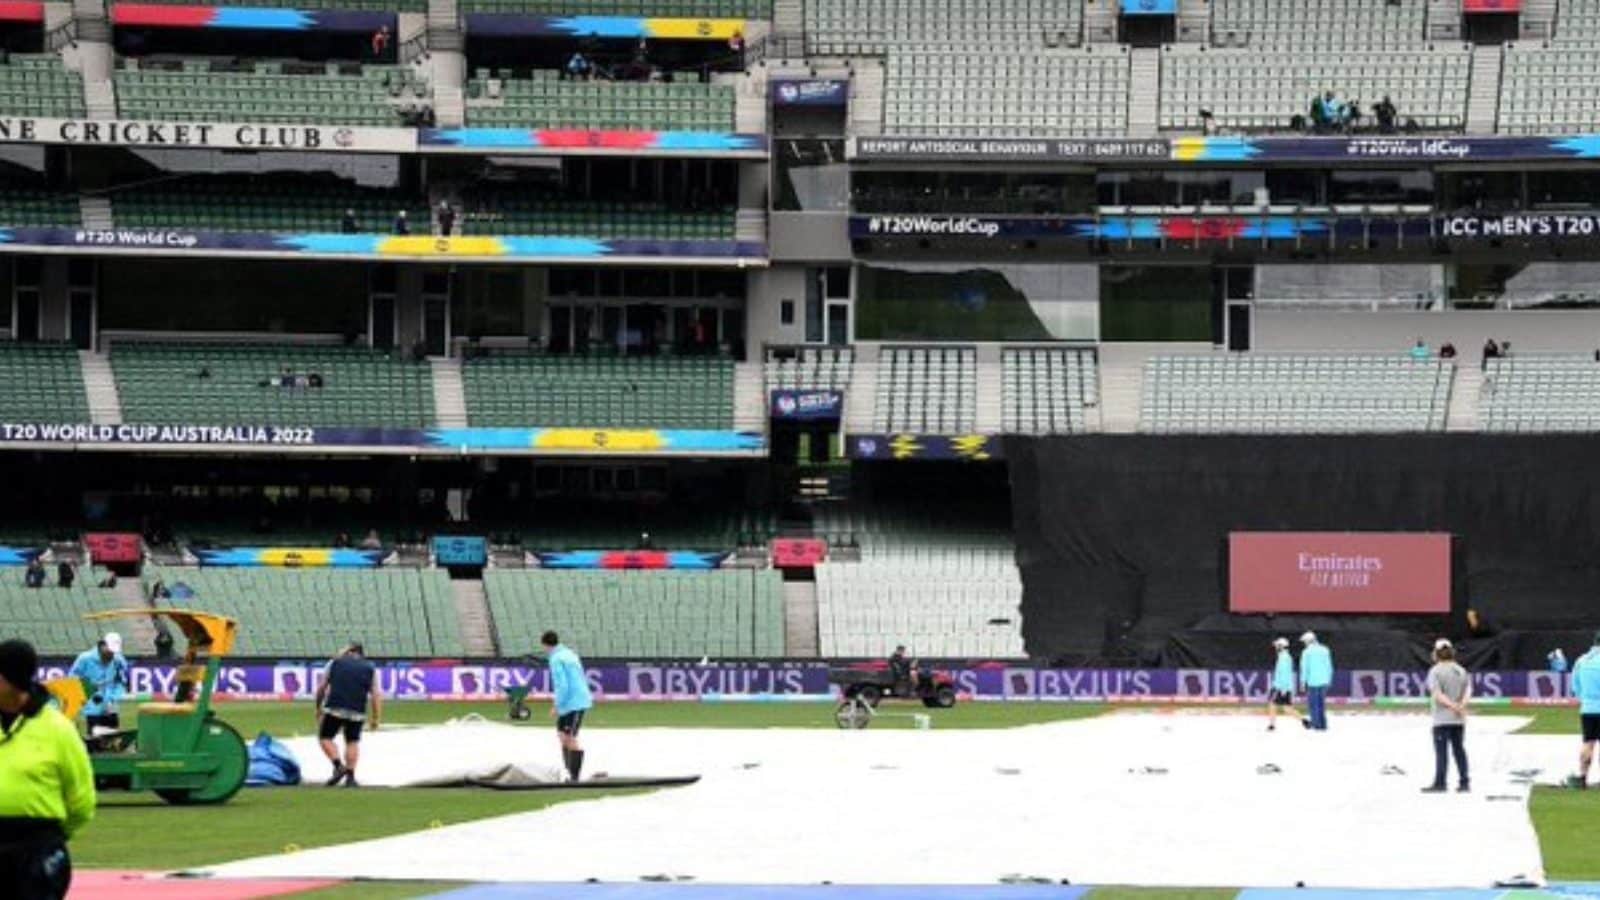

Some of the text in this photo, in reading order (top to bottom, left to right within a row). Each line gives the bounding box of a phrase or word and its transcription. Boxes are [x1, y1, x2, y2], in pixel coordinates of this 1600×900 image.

[60, 121, 213, 147] CRICKET
[236, 125, 320, 147] CLUB
[862, 140, 907, 153] REPORT
[909, 140, 978, 154] ANTISOCIAL
[1347, 139, 1470, 156] #T20WorldCup
[868, 218, 1000, 236] #T20WorldCup
[1443, 217, 1479, 236] ICC
[1483, 216, 1550, 235] MEN'S
[1555, 215, 1594, 235] T20
[75, 230, 197, 247] #T20 World Cup
[3, 423, 314, 443] T20 WORLD CUP AUSTRALIA 2022
[1298, 551, 1382, 571] Emirates
[1039, 670, 1150, 696] BYJU'S
